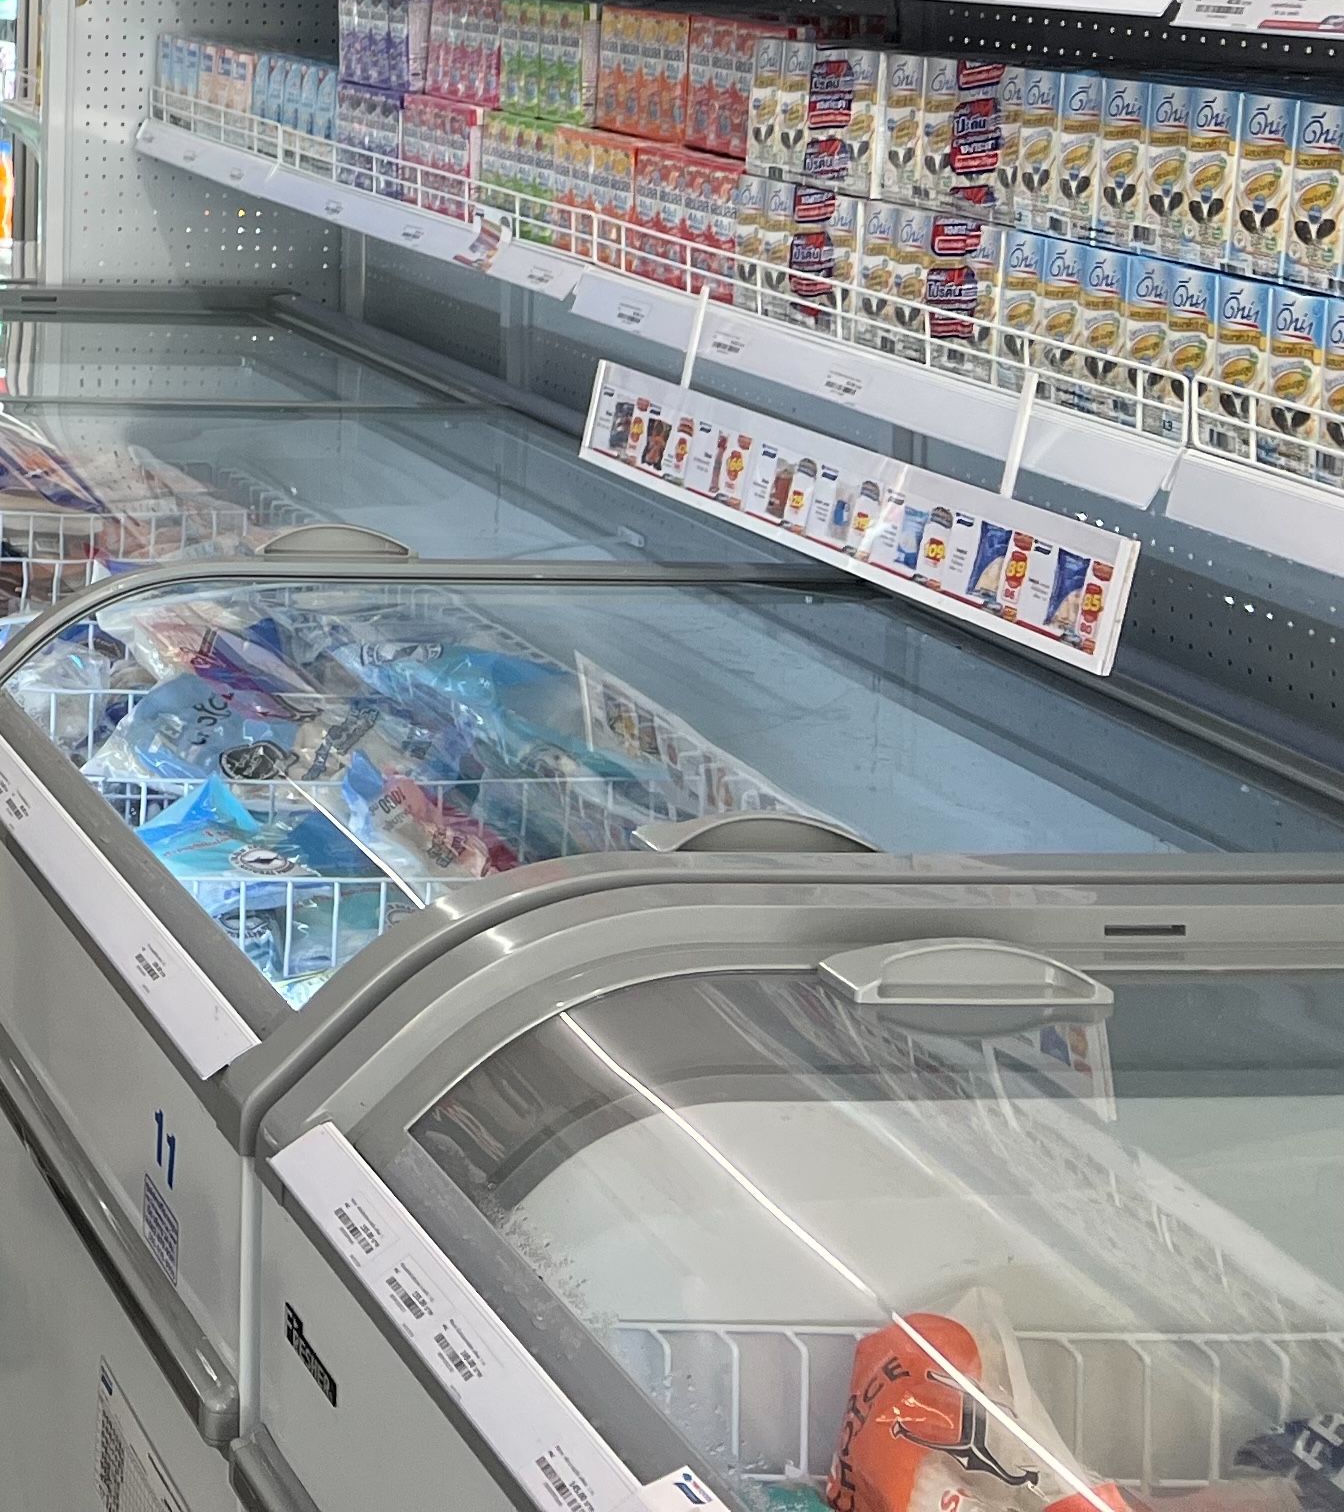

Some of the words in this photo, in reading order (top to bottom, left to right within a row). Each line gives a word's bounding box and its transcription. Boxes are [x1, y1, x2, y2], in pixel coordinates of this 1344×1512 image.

[1196, 96, 1232, 129] ดีน่า
[1248, 103, 1288, 137] ดีน่า
[1172, 276, 1207, 311] ดีน่า
[1222, 288, 1261, 323] ดีน่า
[1275, 301, 1314, 335] ดีน่า
